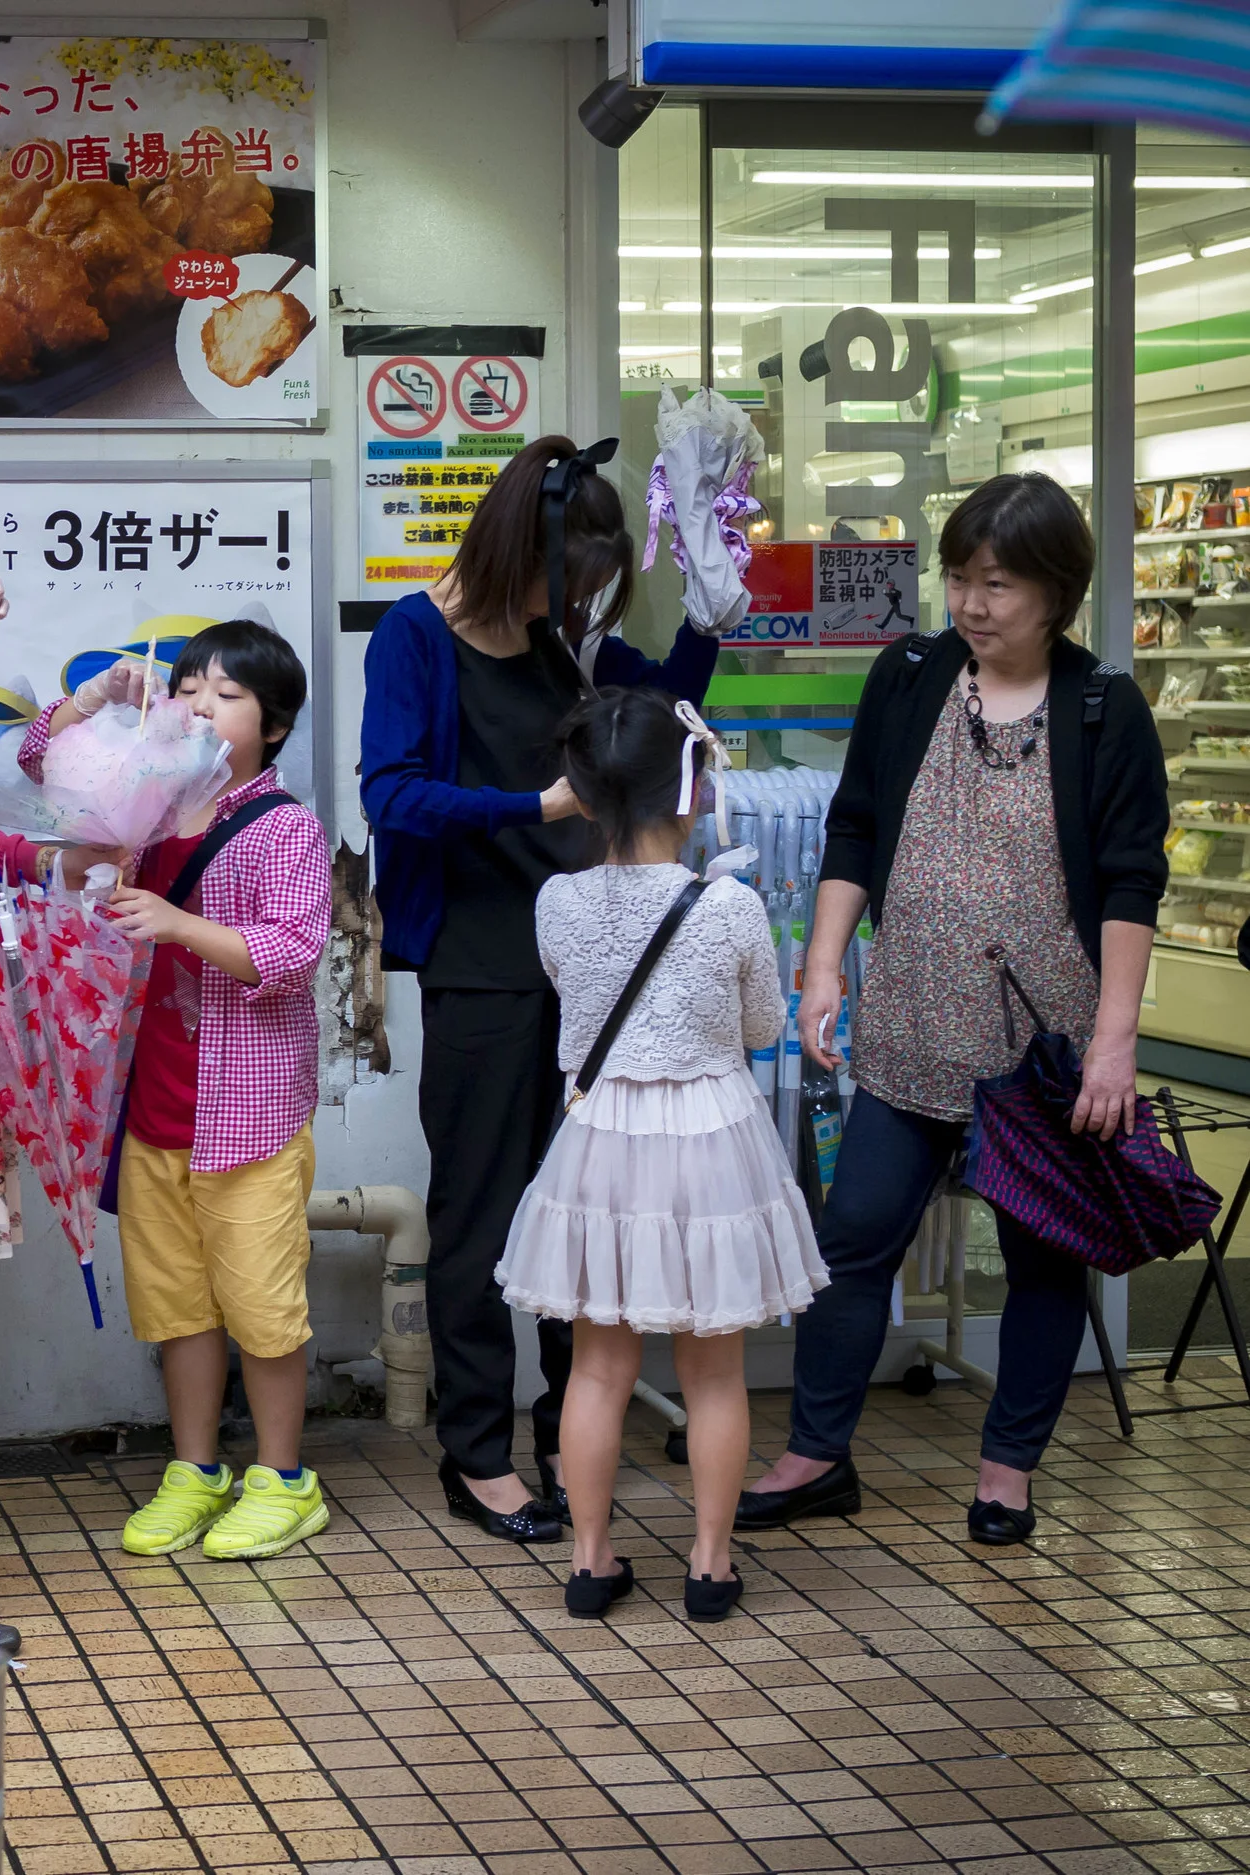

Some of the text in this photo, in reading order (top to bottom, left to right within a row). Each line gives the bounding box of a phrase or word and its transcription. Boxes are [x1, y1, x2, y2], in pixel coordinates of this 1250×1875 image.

[178, 260, 225, 274] やわらか
[174, 276, 230, 290] ジューシー!
[283, 379, 310, 389] Fun &
[283, 390, 311, 400] Fresh
[458, 436, 525, 444] No eating
[367, 446, 384, 457] No
[388, 445, 443, 457] smorking
[479, 447, 523, 456] drinki
[382, 501, 483, 514] また、長時間の
[43, 507, 291, 572] 3倍ザー!
[404, 529, 466, 542] ご遠慮下
[819, 549, 917, 568] 防犯カメラで
[819, 567, 889, 585] セコムが
[752, 593, 783, 603] ecurity
[819, 584, 876, 603] 監視中
[759, 602, 771, 611] by
[819, 629, 908, 641] Monitored by Came
